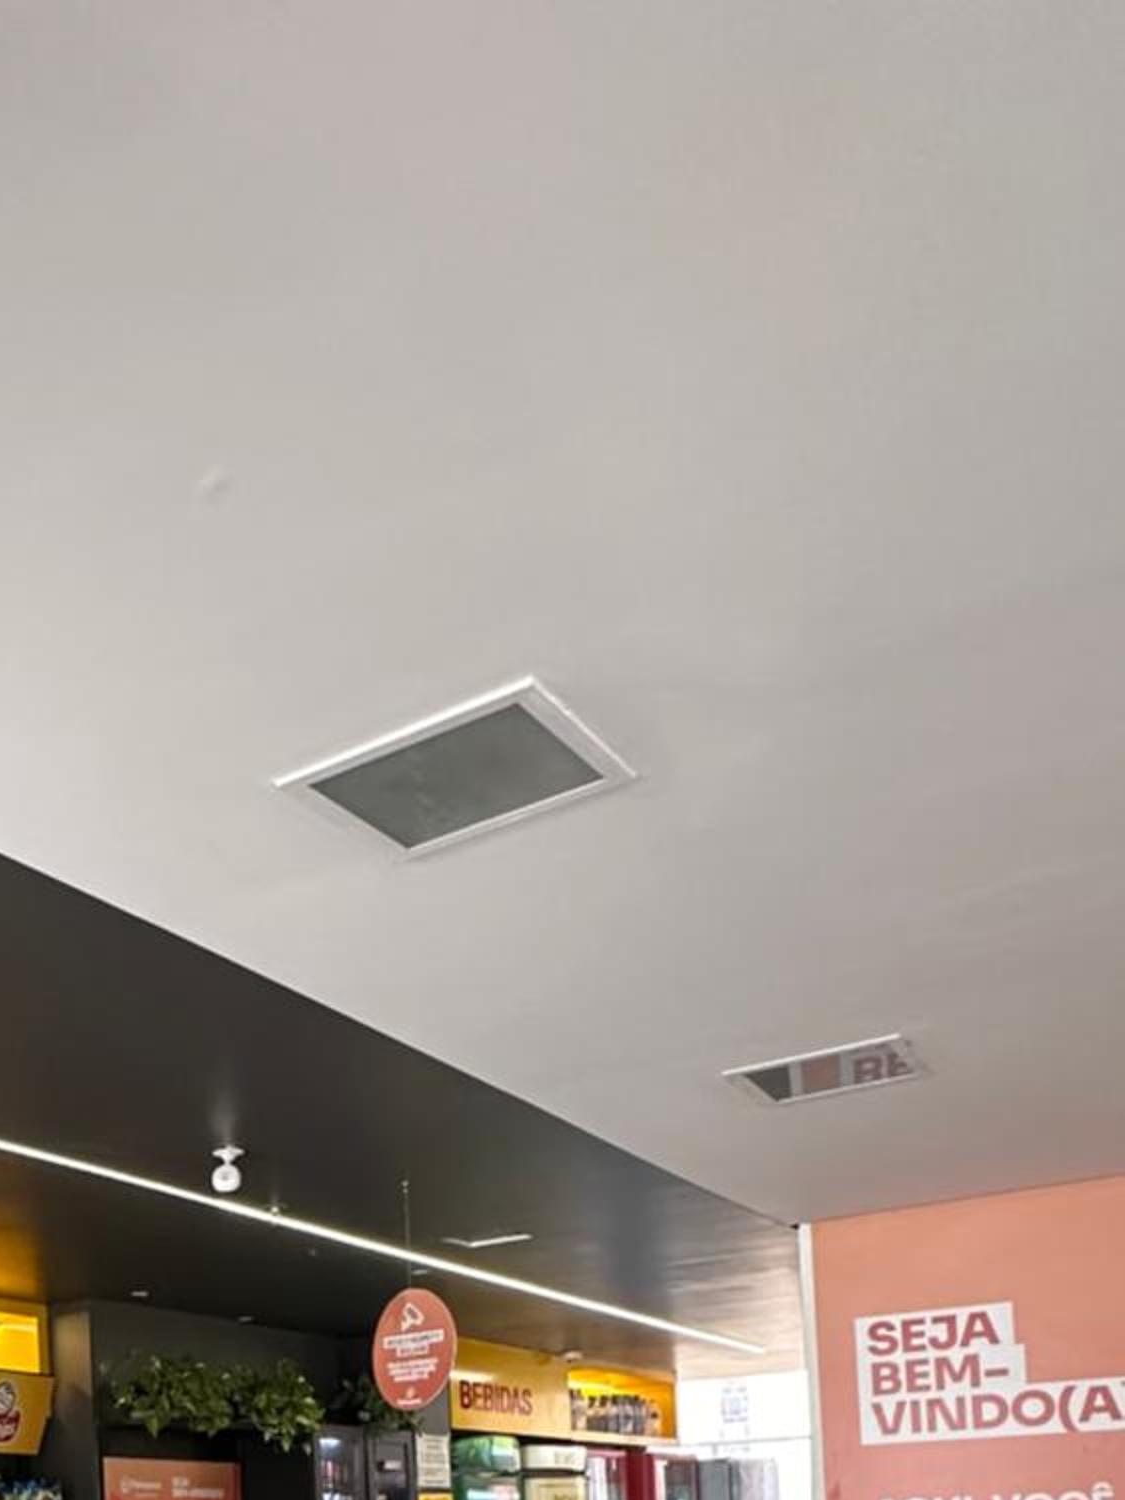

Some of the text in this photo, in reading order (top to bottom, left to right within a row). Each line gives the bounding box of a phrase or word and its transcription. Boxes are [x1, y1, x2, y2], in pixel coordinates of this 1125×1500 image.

[867, 1311, 1001, 1356] SEJA
[870, 1353, 1010, 1396] BEM-
[459, 1380, 533, 1416] BEBIDAS
[871, 1382, 1125, 1435] VINDO(A
